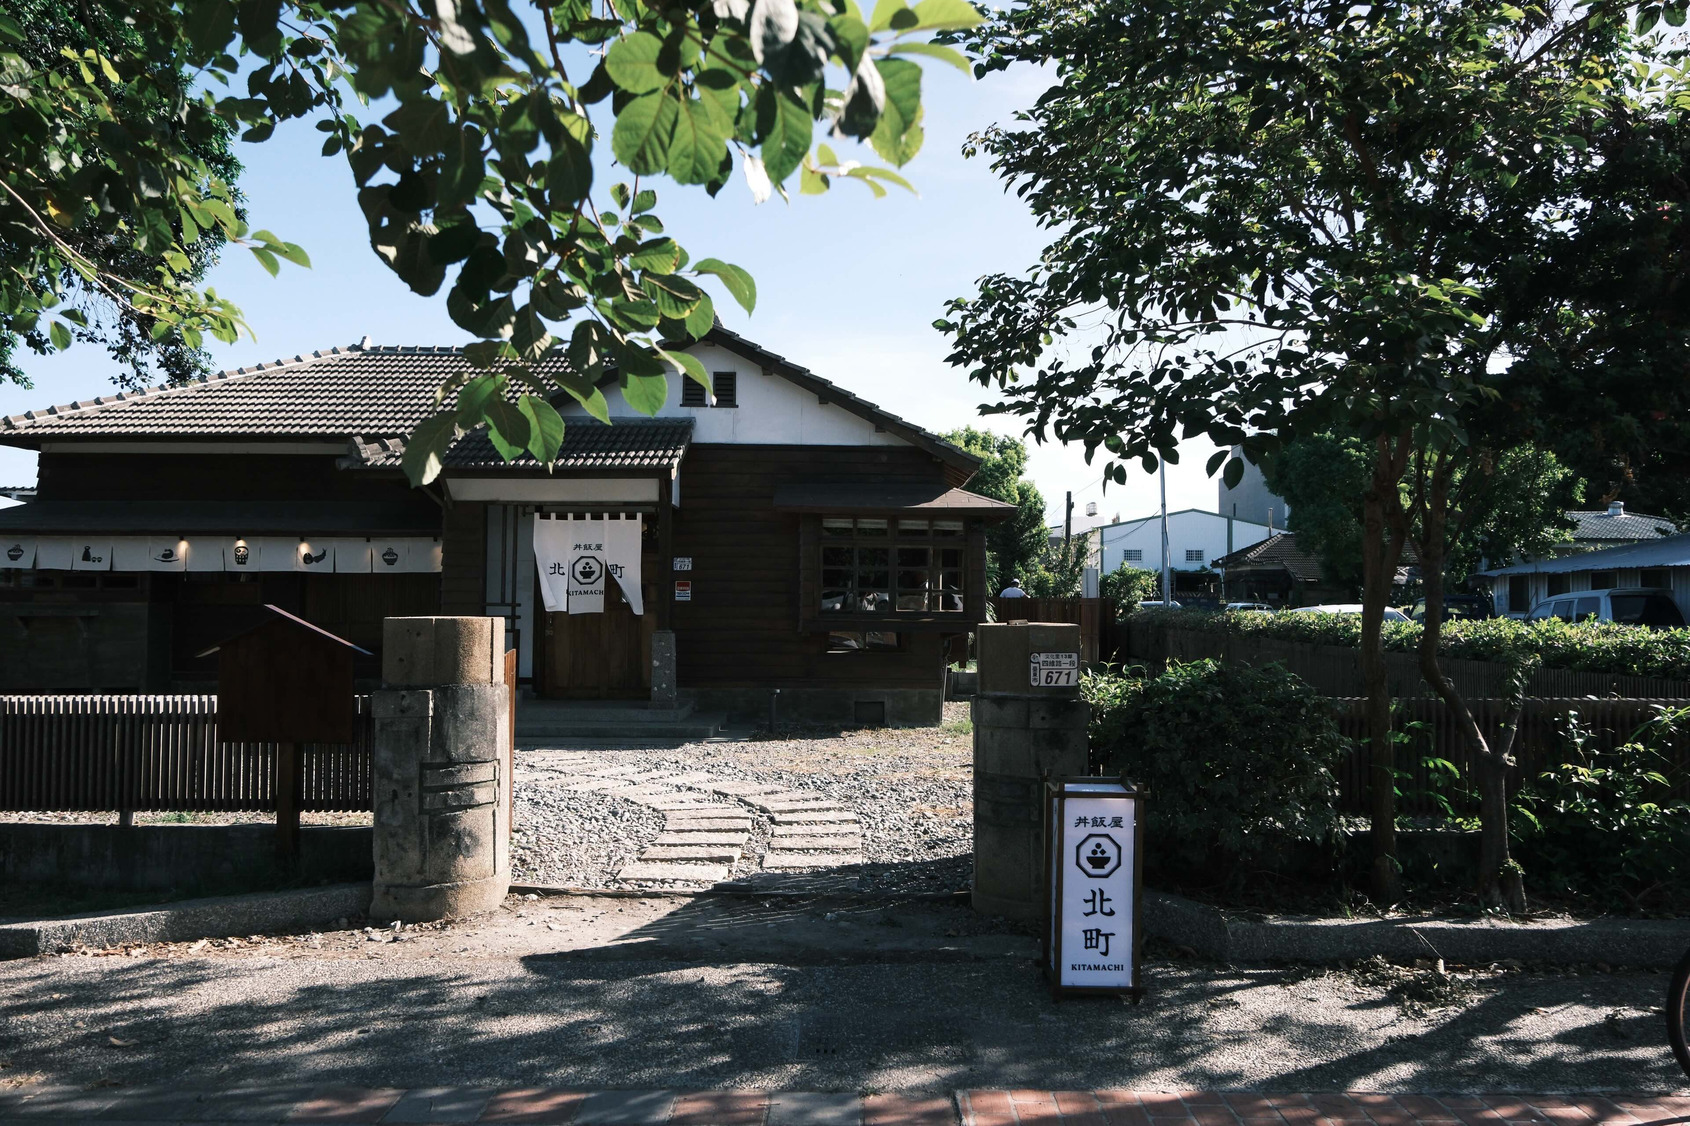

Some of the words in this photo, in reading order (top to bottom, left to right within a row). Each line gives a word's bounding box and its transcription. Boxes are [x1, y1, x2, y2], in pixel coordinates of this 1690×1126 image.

[549, 562, 566, 576] 北
[609, 563, 625, 579] 町
[1045, 671, 1071, 684] 671
[1074, 816, 1124, 829] 丼飯屋
[1082, 887, 1116, 957] 北町
[1071, 964, 1124, 972] KITAMACHI
